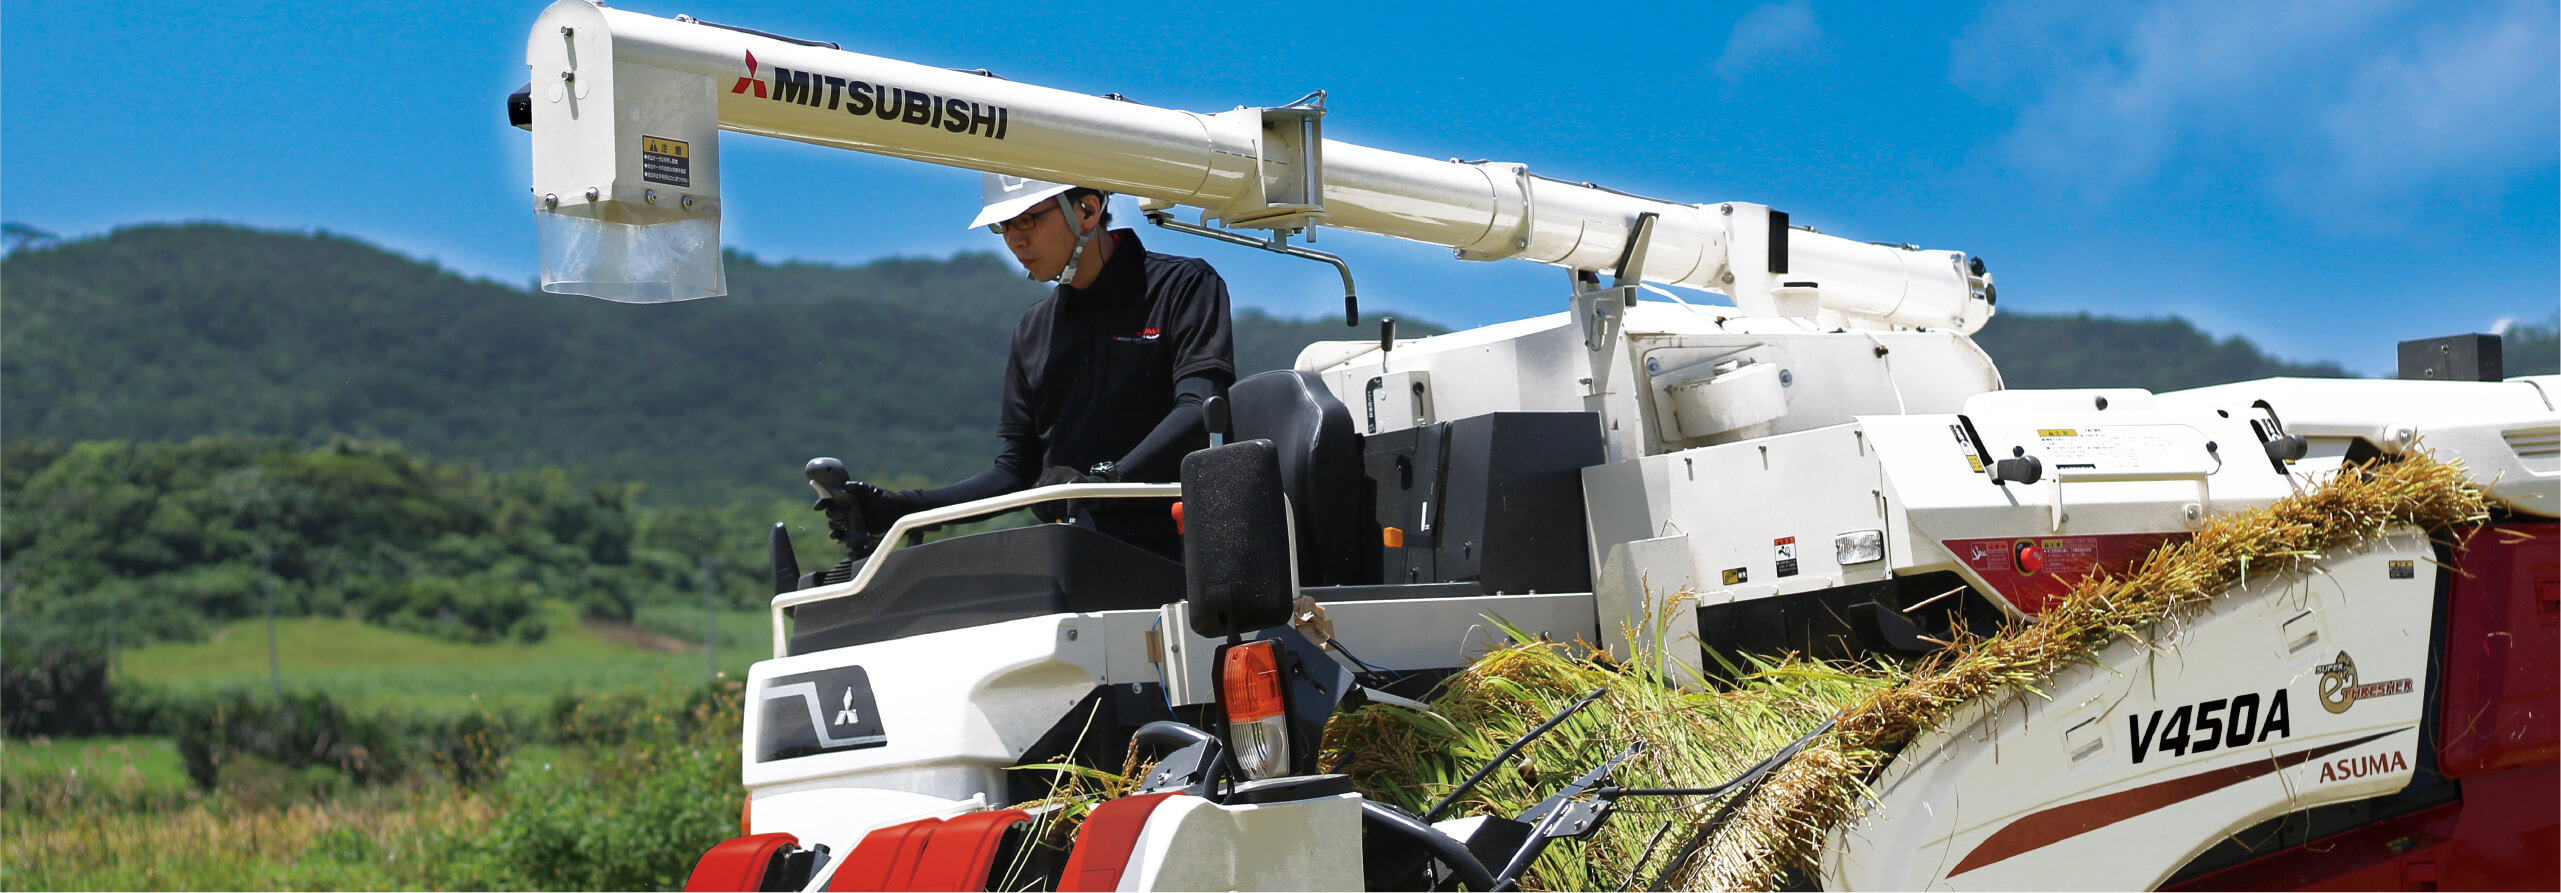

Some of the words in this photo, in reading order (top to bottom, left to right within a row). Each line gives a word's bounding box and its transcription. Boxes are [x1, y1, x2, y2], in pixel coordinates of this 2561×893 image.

[772, 67, 1008, 140] MITSUBISHI
[2316, 663, 2345, 674] SUPER
[2342, 679, 2413, 700] THRESHER
[2129, 688, 2290, 764] V450A
[2320, 751, 2408, 783] ASUMA
